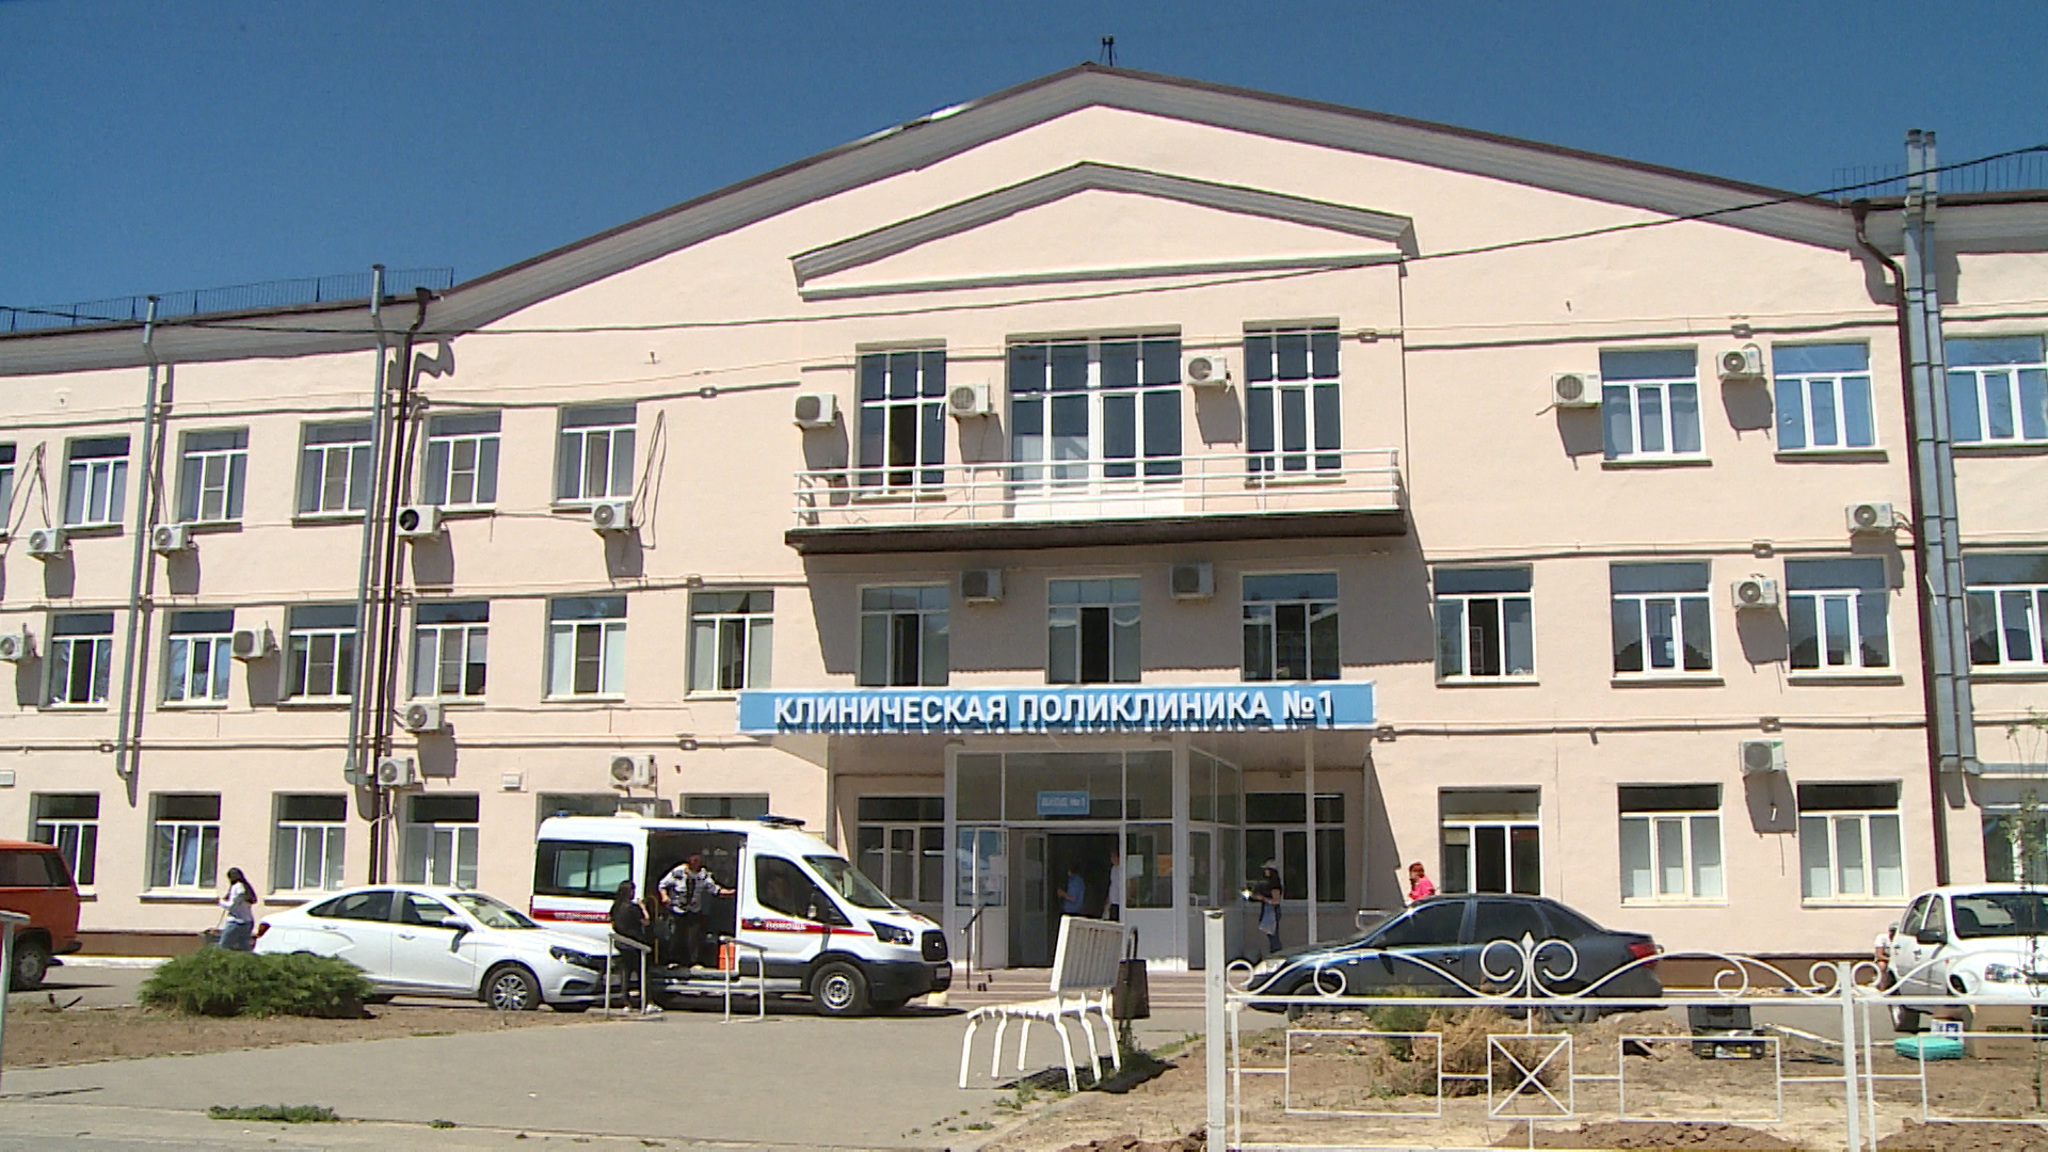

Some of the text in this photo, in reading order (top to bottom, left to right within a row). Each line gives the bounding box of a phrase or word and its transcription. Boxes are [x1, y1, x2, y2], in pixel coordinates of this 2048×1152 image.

[774, 690, 1333, 724] КЛИНИЧЕСКАЯ ПОЛИКЛИНИКА №1
